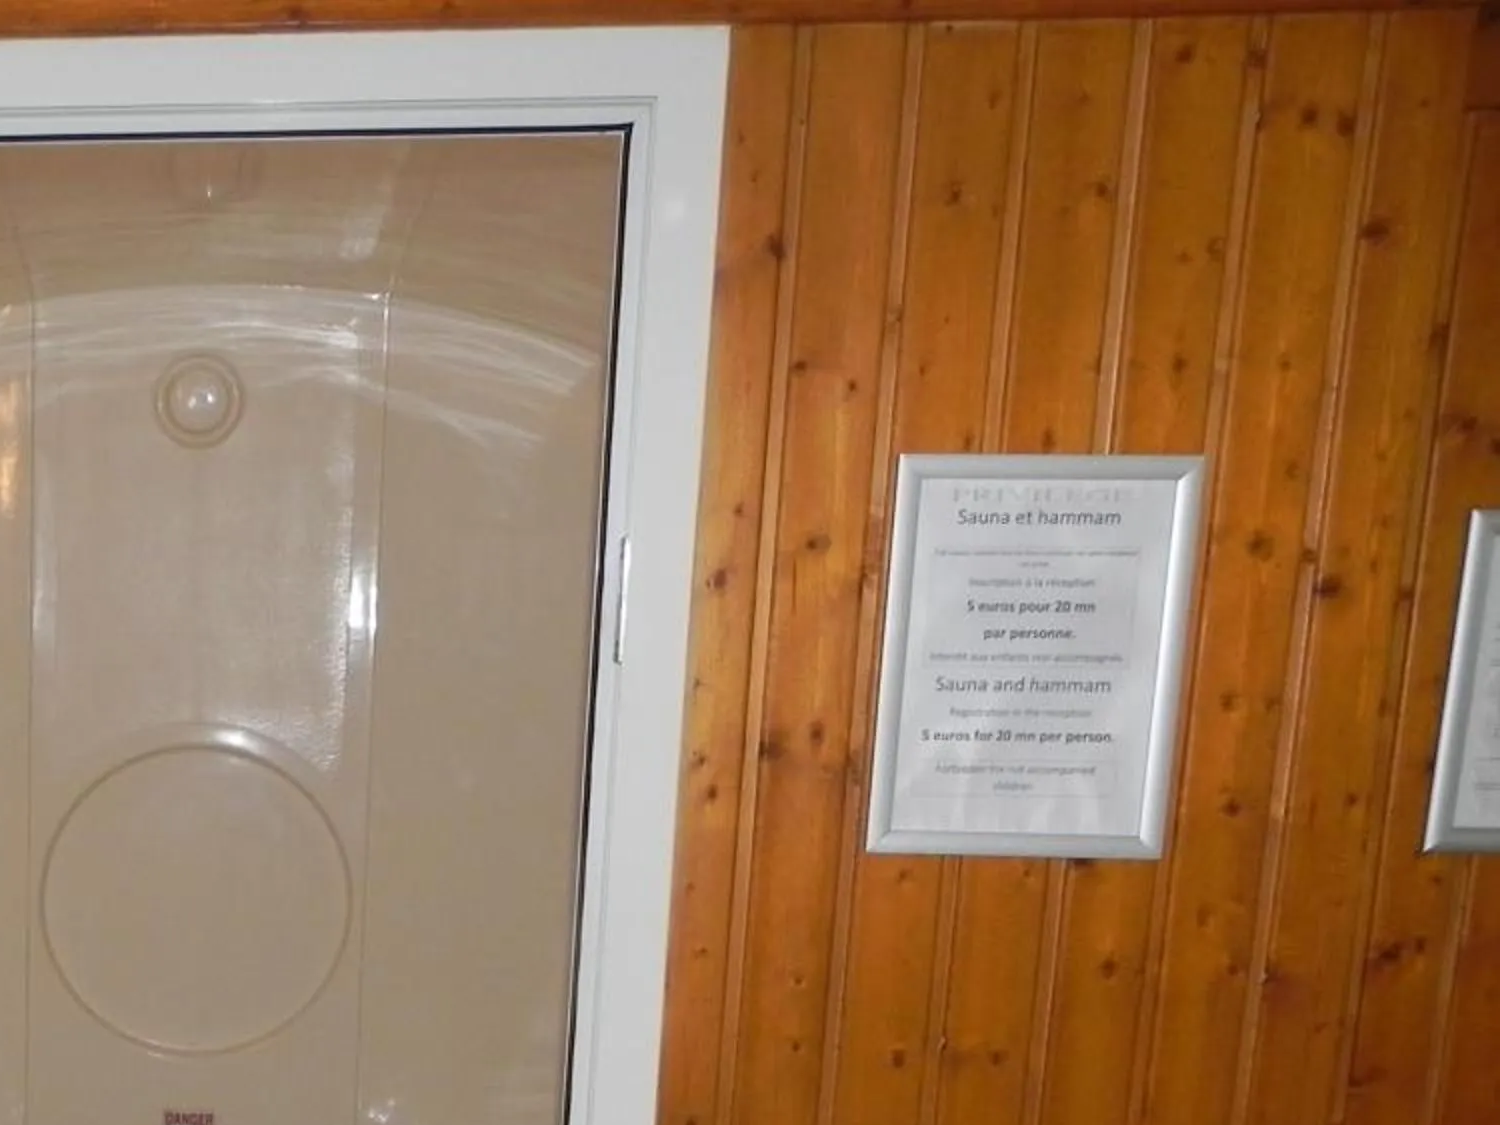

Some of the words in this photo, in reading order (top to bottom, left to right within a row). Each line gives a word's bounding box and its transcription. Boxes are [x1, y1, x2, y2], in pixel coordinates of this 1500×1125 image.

[956, 508, 1011, 525] Sauna
[1015, 511, 1033, 525] et
[1037, 509, 1122, 525] hammam
[967, 600, 975, 613] 5
[978, 602, 1015, 613] euros
[1019, 602, 1050, 615] pour
[1055, 600, 1071, 613] 20
[1075, 602, 1096, 613] mn
[983, 629, 1005, 641] par
[1010, 629, 1077, 641] personne.
[935, 675, 988, 692] Sauna
[993, 676, 1025, 692] and
[1030, 676, 1112, 693] hammam
[921, 729, 930, 741] 5
[933, 731, 970, 741] euros
[974, 729, 993, 741] for
[996, 730, 1011, 742] 20
[1014, 731, 1036, 742] mn
[1039, 732, 1061, 744] per
